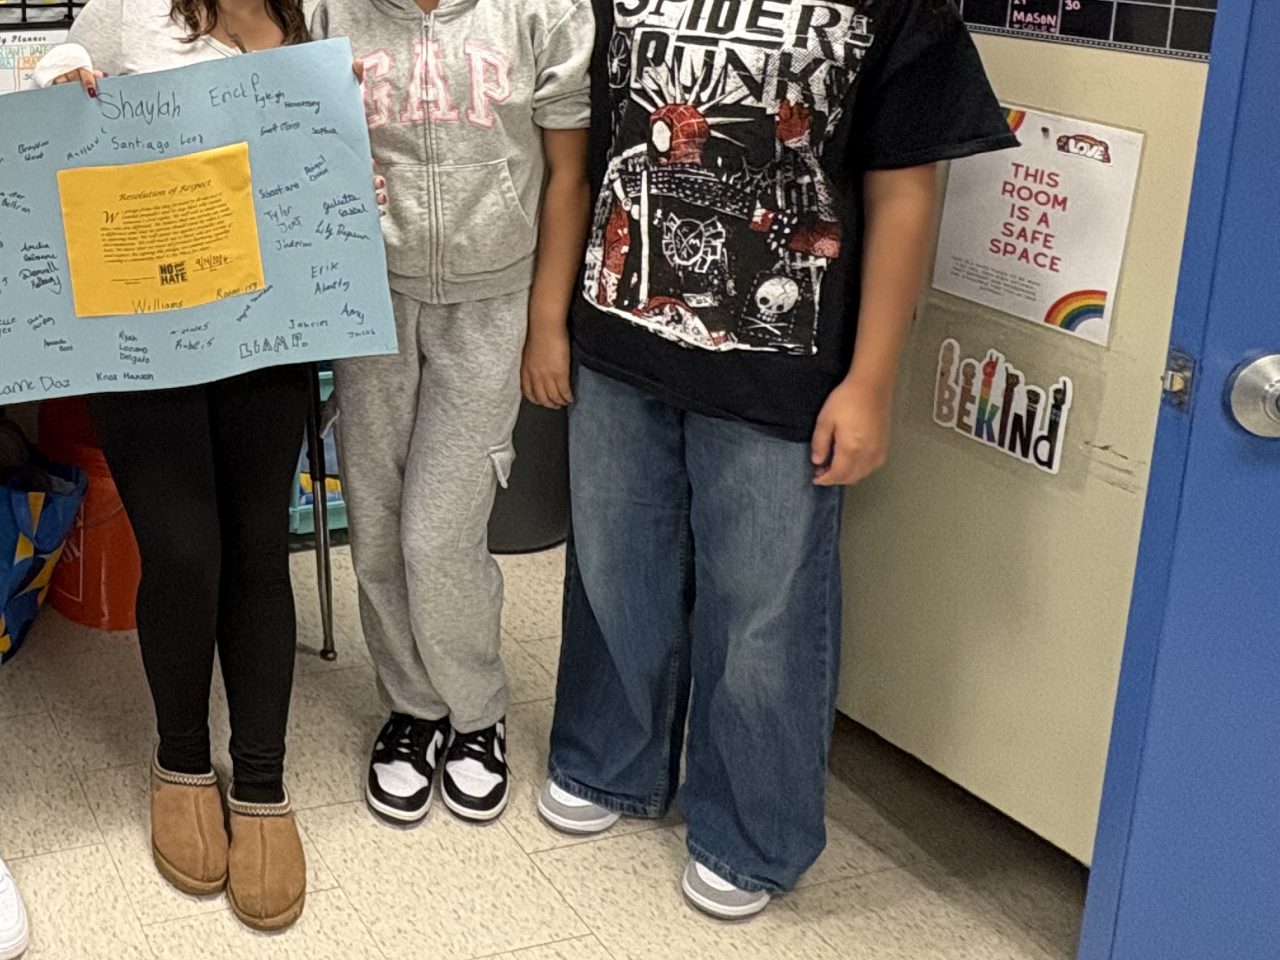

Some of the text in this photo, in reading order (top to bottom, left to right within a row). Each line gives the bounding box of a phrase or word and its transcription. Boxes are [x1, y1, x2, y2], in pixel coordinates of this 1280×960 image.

[1064, 0, 1081, 11] 30
[1012, 9, 1058, 27] MASON
[11, 34, 47, 43] Planner
[635, 28, 827, 108] PUNK
[362, 38, 513, 130] GAP
[96, 90, 182, 125] Shaylah
[1068, 139, 1107, 161] LOVE
[1011, 161, 1061, 189] THIS
[118, 179, 212, 202] Resolution of Respect
[1000, 180, 1069, 213] ROOM
[1009, 204, 1051, 230] IS A
[1000, 221, 1055, 251] SAFE
[988, 237, 1063, 274] SPACE
[159, 263, 174, 276] NO
[160, 272, 188, 286] HATE
[131, 298, 184, 314] Williams
